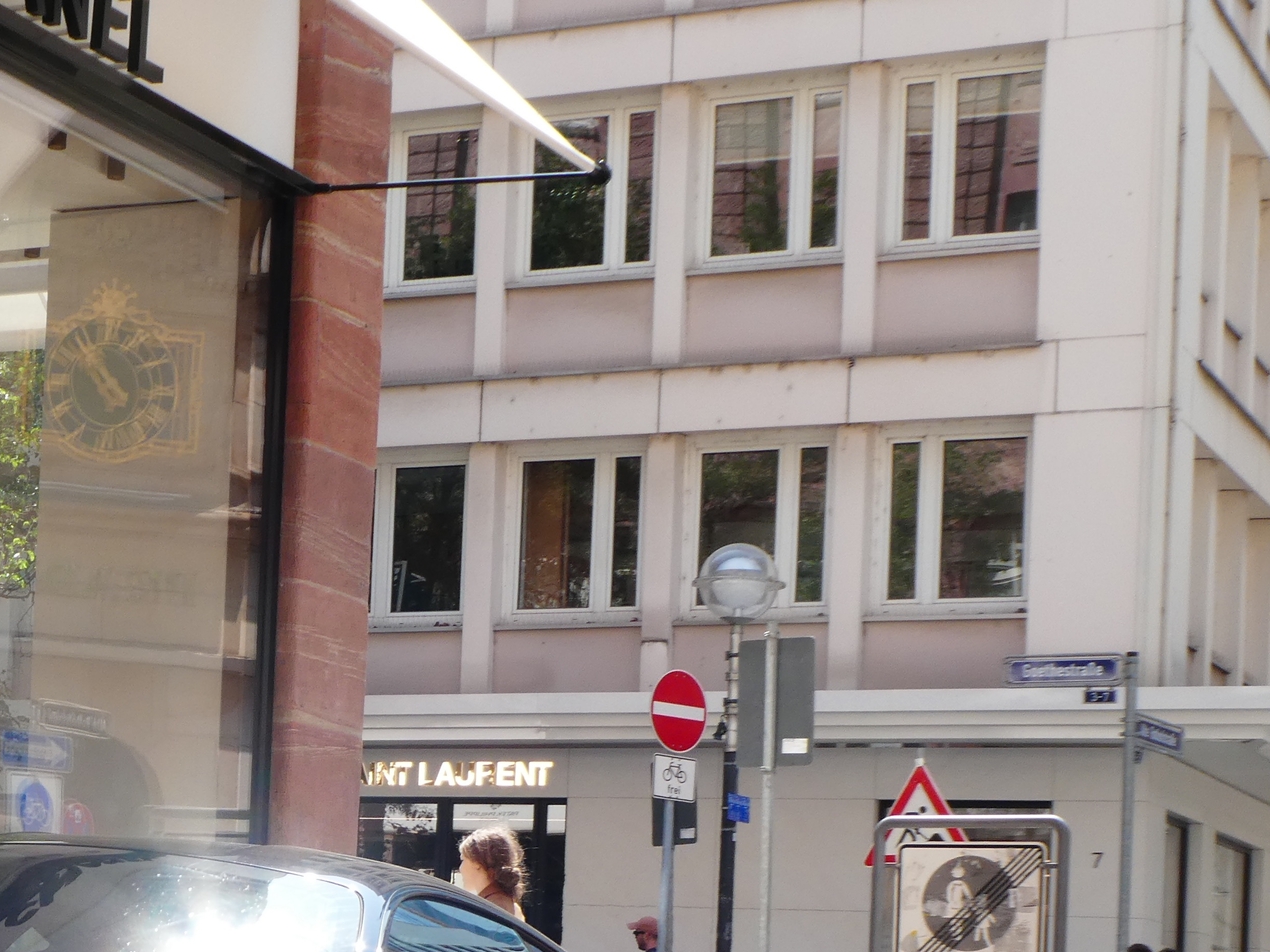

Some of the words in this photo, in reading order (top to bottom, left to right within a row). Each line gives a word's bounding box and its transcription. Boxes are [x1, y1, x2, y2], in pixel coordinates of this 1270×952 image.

[1022, 661, 1104, 678] Goethestraße
[1090, 691, 1110, 702] 3-7
[418, 760, 554, 787] LAURENT
[667, 784, 681, 795] frei
[1091, 851, 1104, 869] 7
